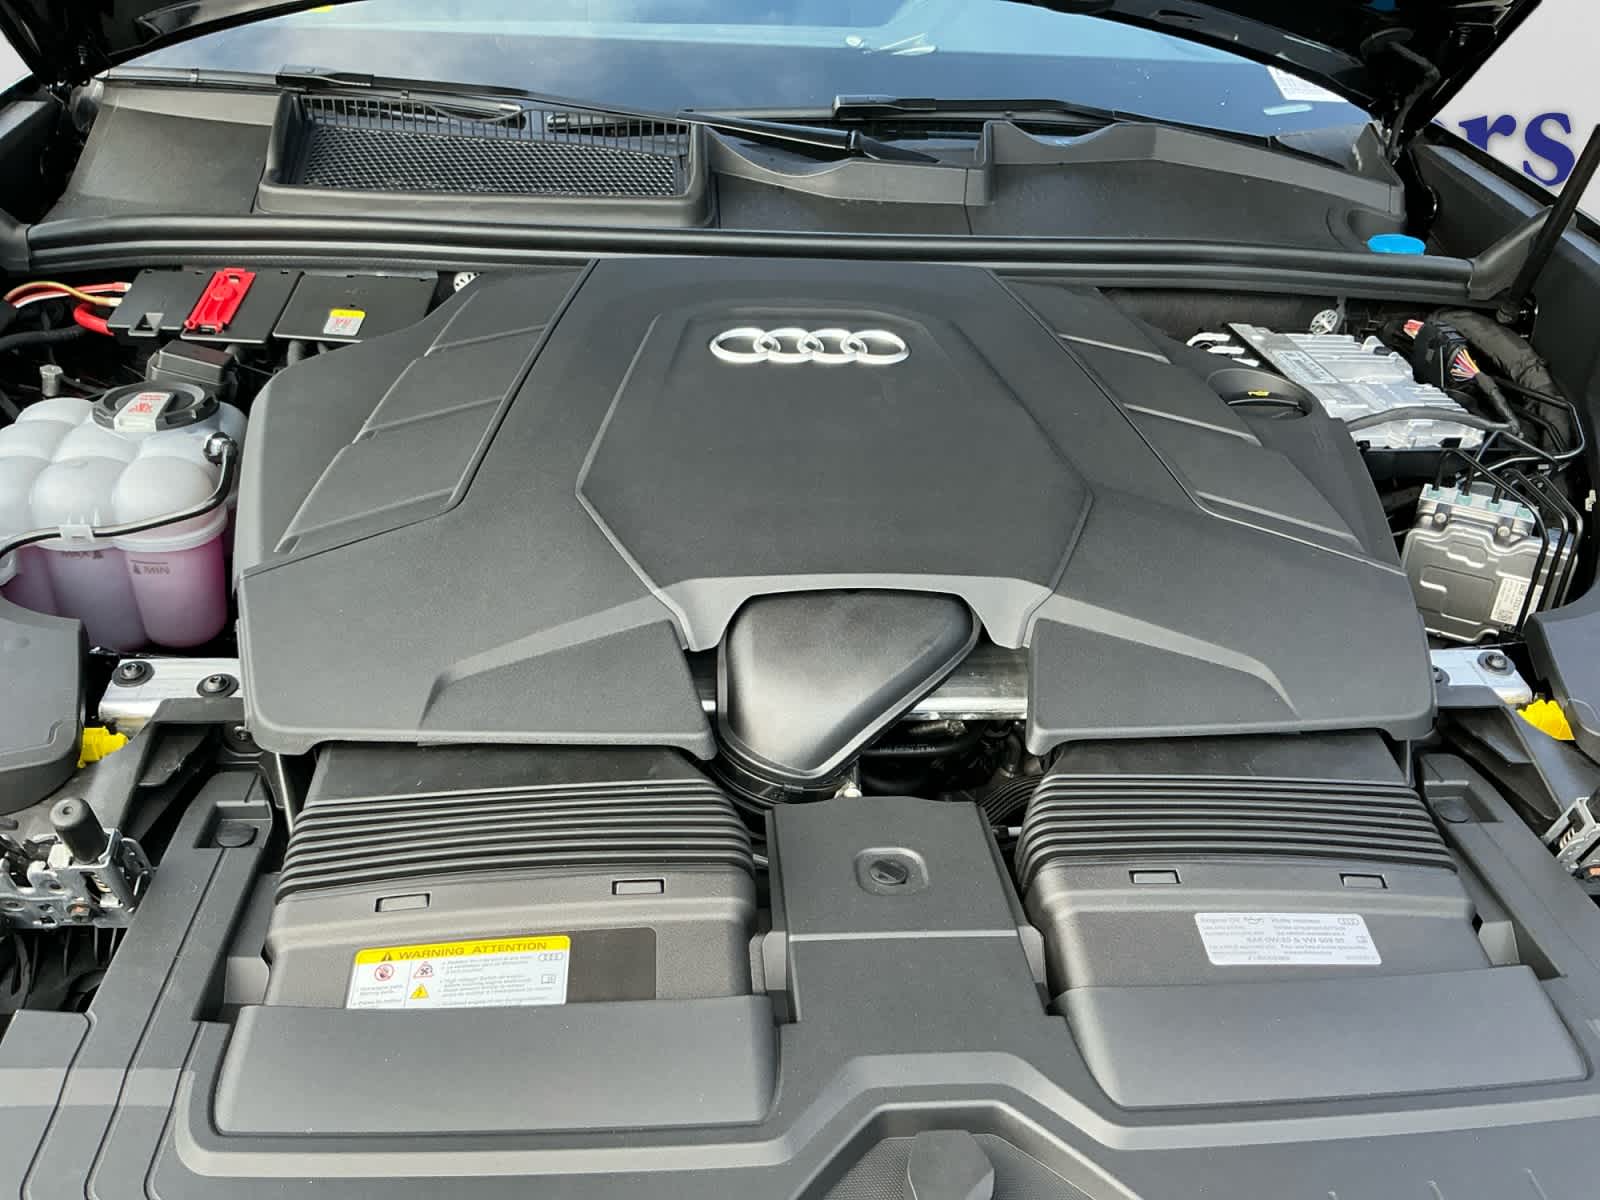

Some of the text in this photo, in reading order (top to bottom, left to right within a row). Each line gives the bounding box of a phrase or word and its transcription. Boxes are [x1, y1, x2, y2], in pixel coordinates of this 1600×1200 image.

[1434, 112, 1575, 186] rs
[143, 565, 170, 575] MIN
[399, 942, 547, 959] WARNING ATTENTION
